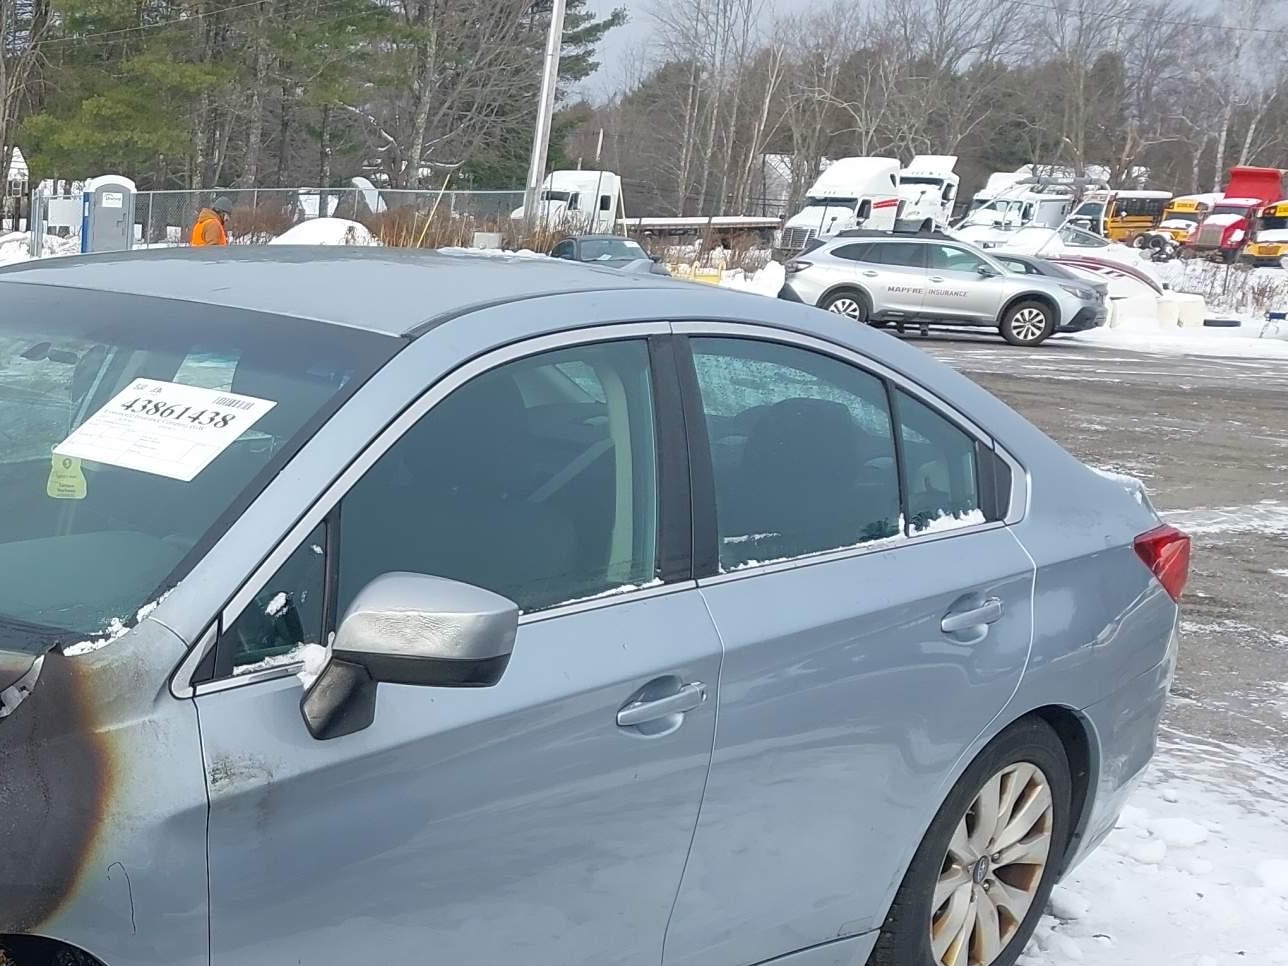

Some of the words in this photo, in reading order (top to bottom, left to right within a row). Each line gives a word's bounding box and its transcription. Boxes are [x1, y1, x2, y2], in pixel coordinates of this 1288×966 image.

[888, 286, 924, 295] MAPFRE
[928, 288, 968, 297] INSURANCE
[120, 397, 238, 429] 43861438
